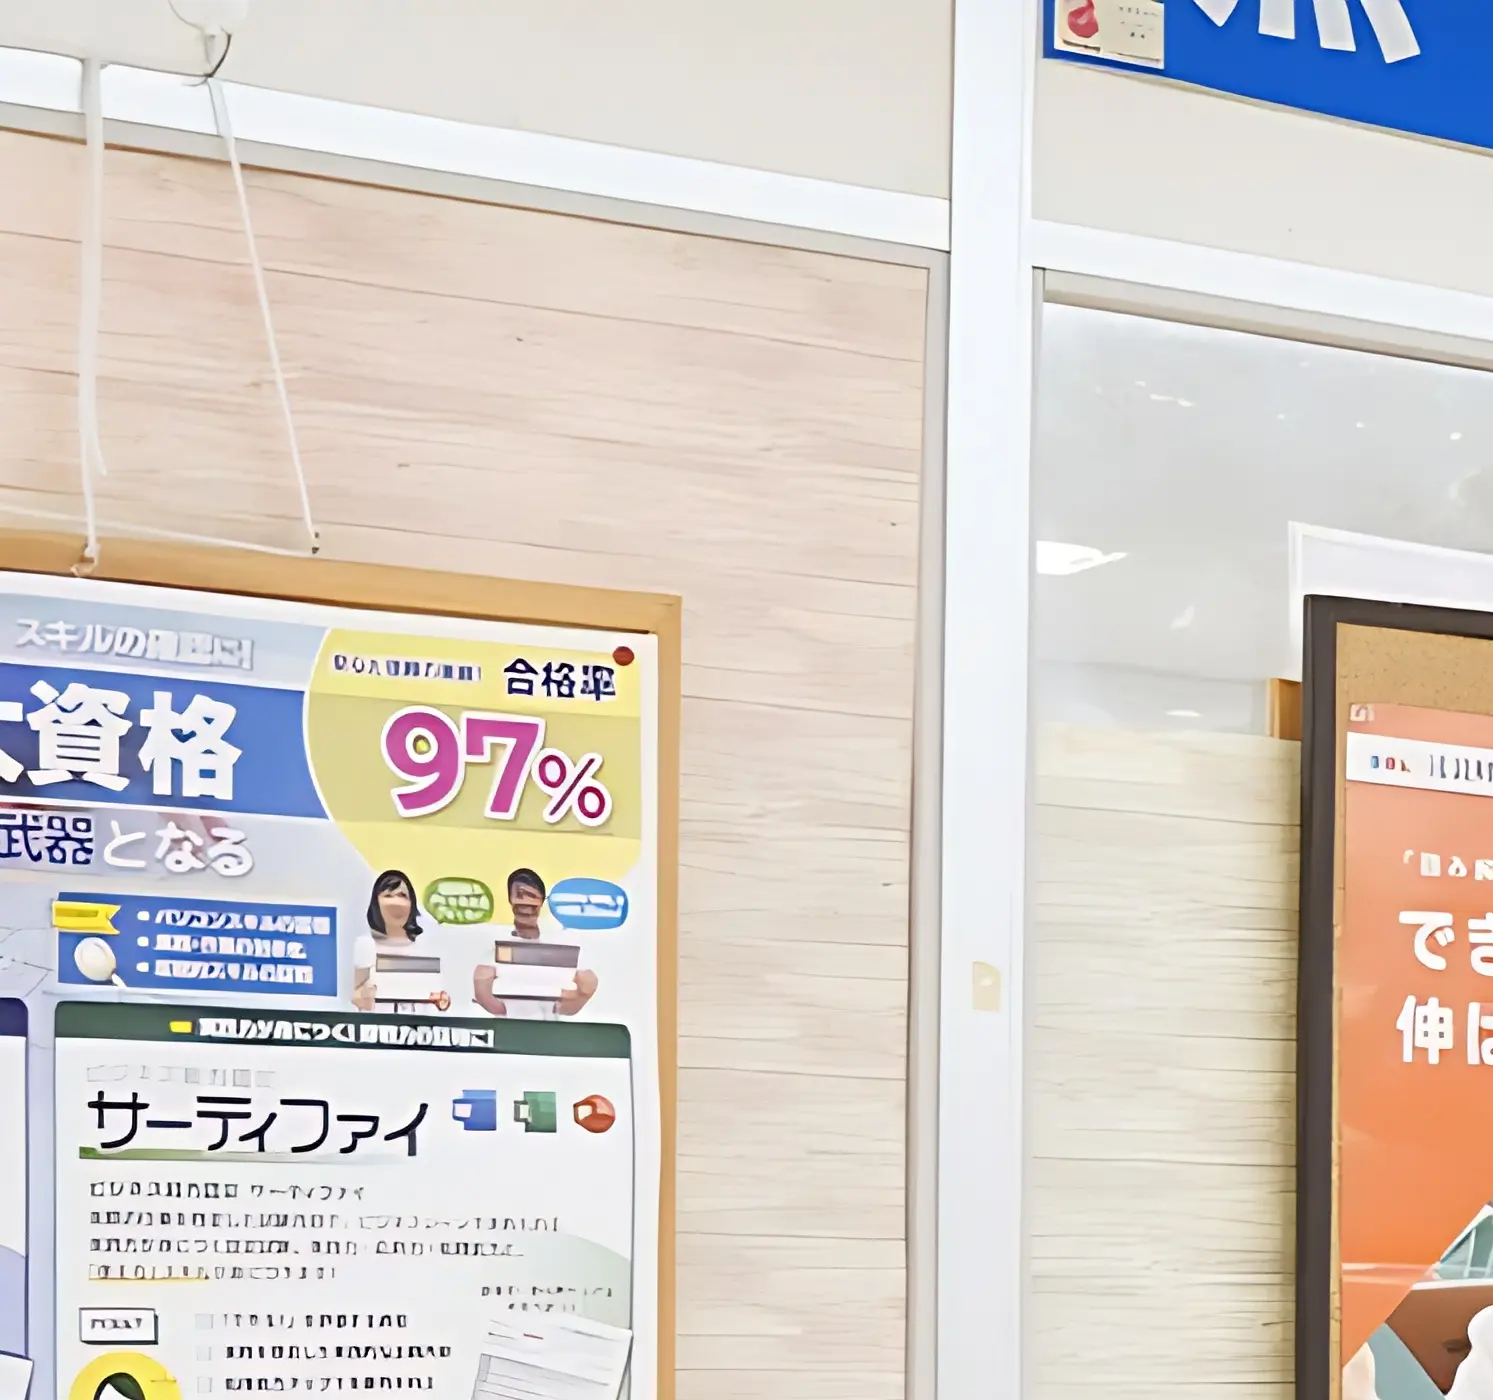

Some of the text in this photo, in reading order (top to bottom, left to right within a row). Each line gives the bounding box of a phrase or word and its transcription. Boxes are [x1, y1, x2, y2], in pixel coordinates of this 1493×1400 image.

[383, 706, 610, 825] 97%
[87, 1090, 430, 1157] サーティファイ
